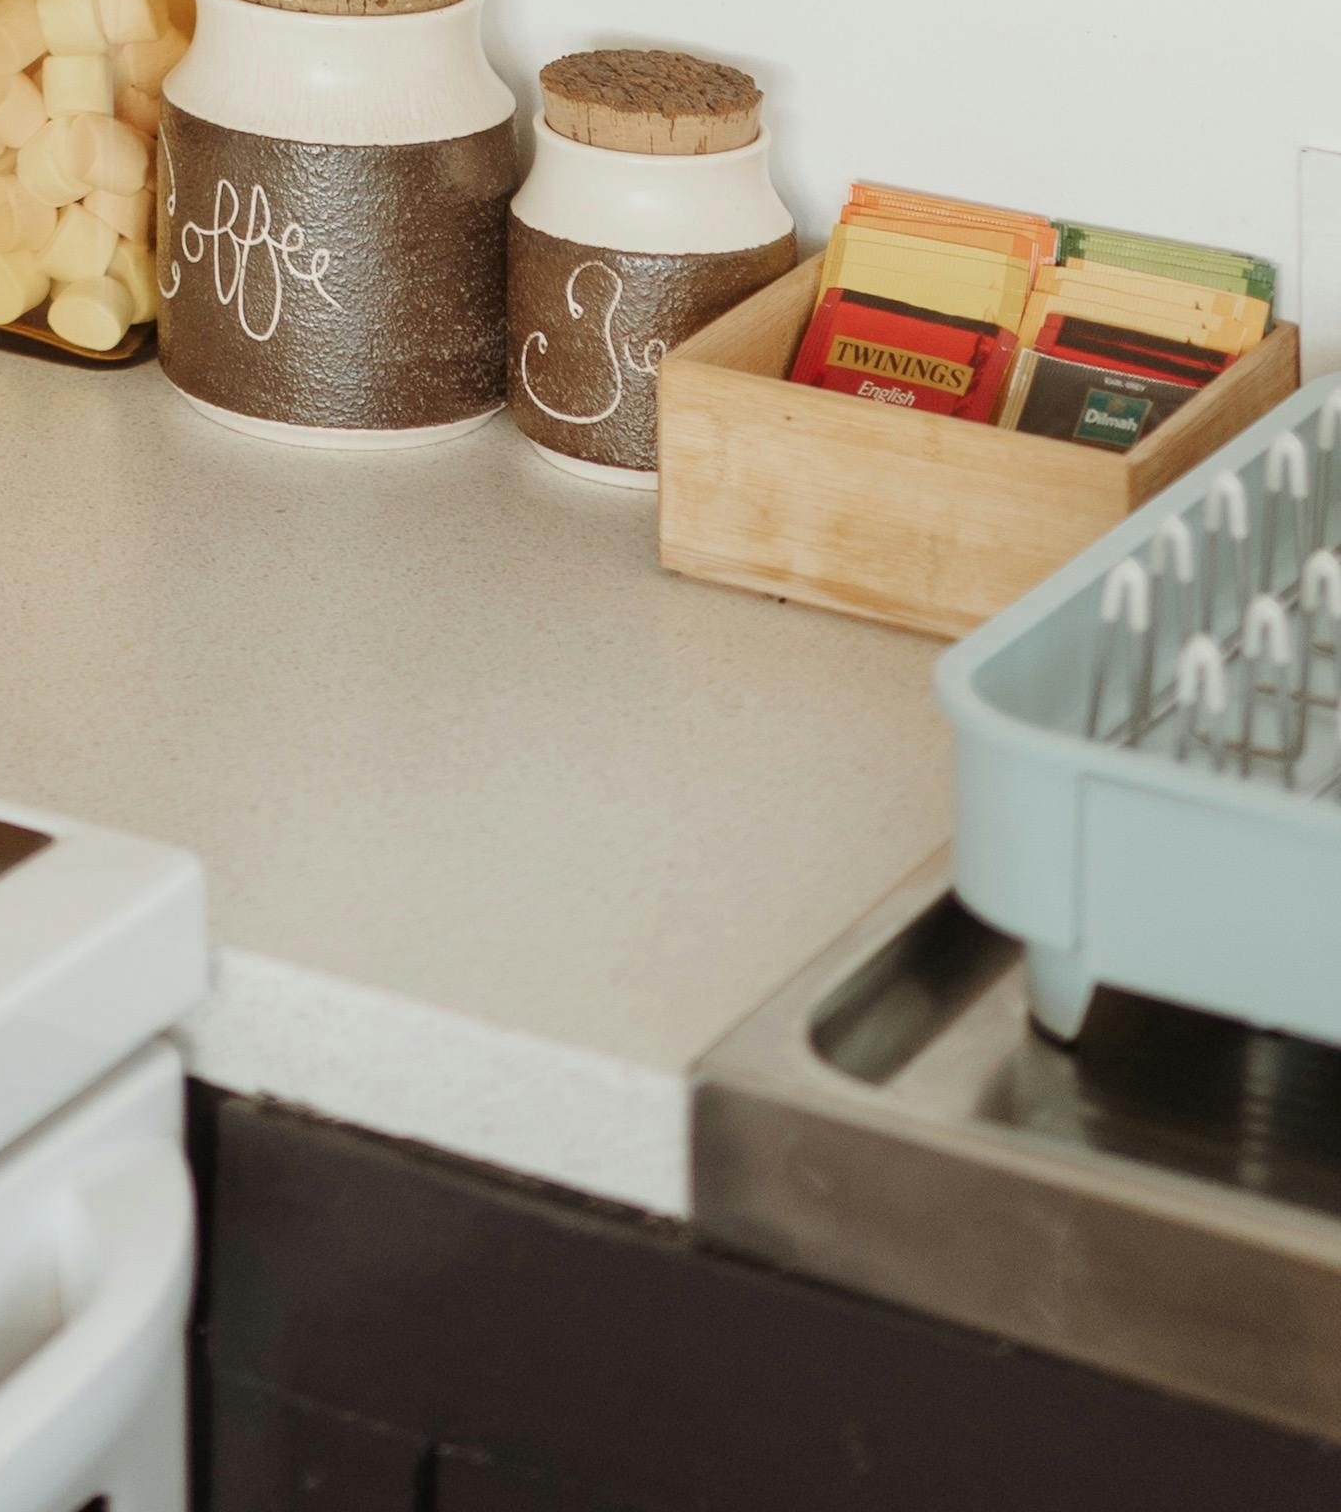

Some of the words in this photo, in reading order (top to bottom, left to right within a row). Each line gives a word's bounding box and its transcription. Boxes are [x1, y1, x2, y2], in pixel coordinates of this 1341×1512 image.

[837, 341, 966, 389] TWININGS
[857, 381, 915, 407] English
[1084, 408, 1138, 432] Dilmah
